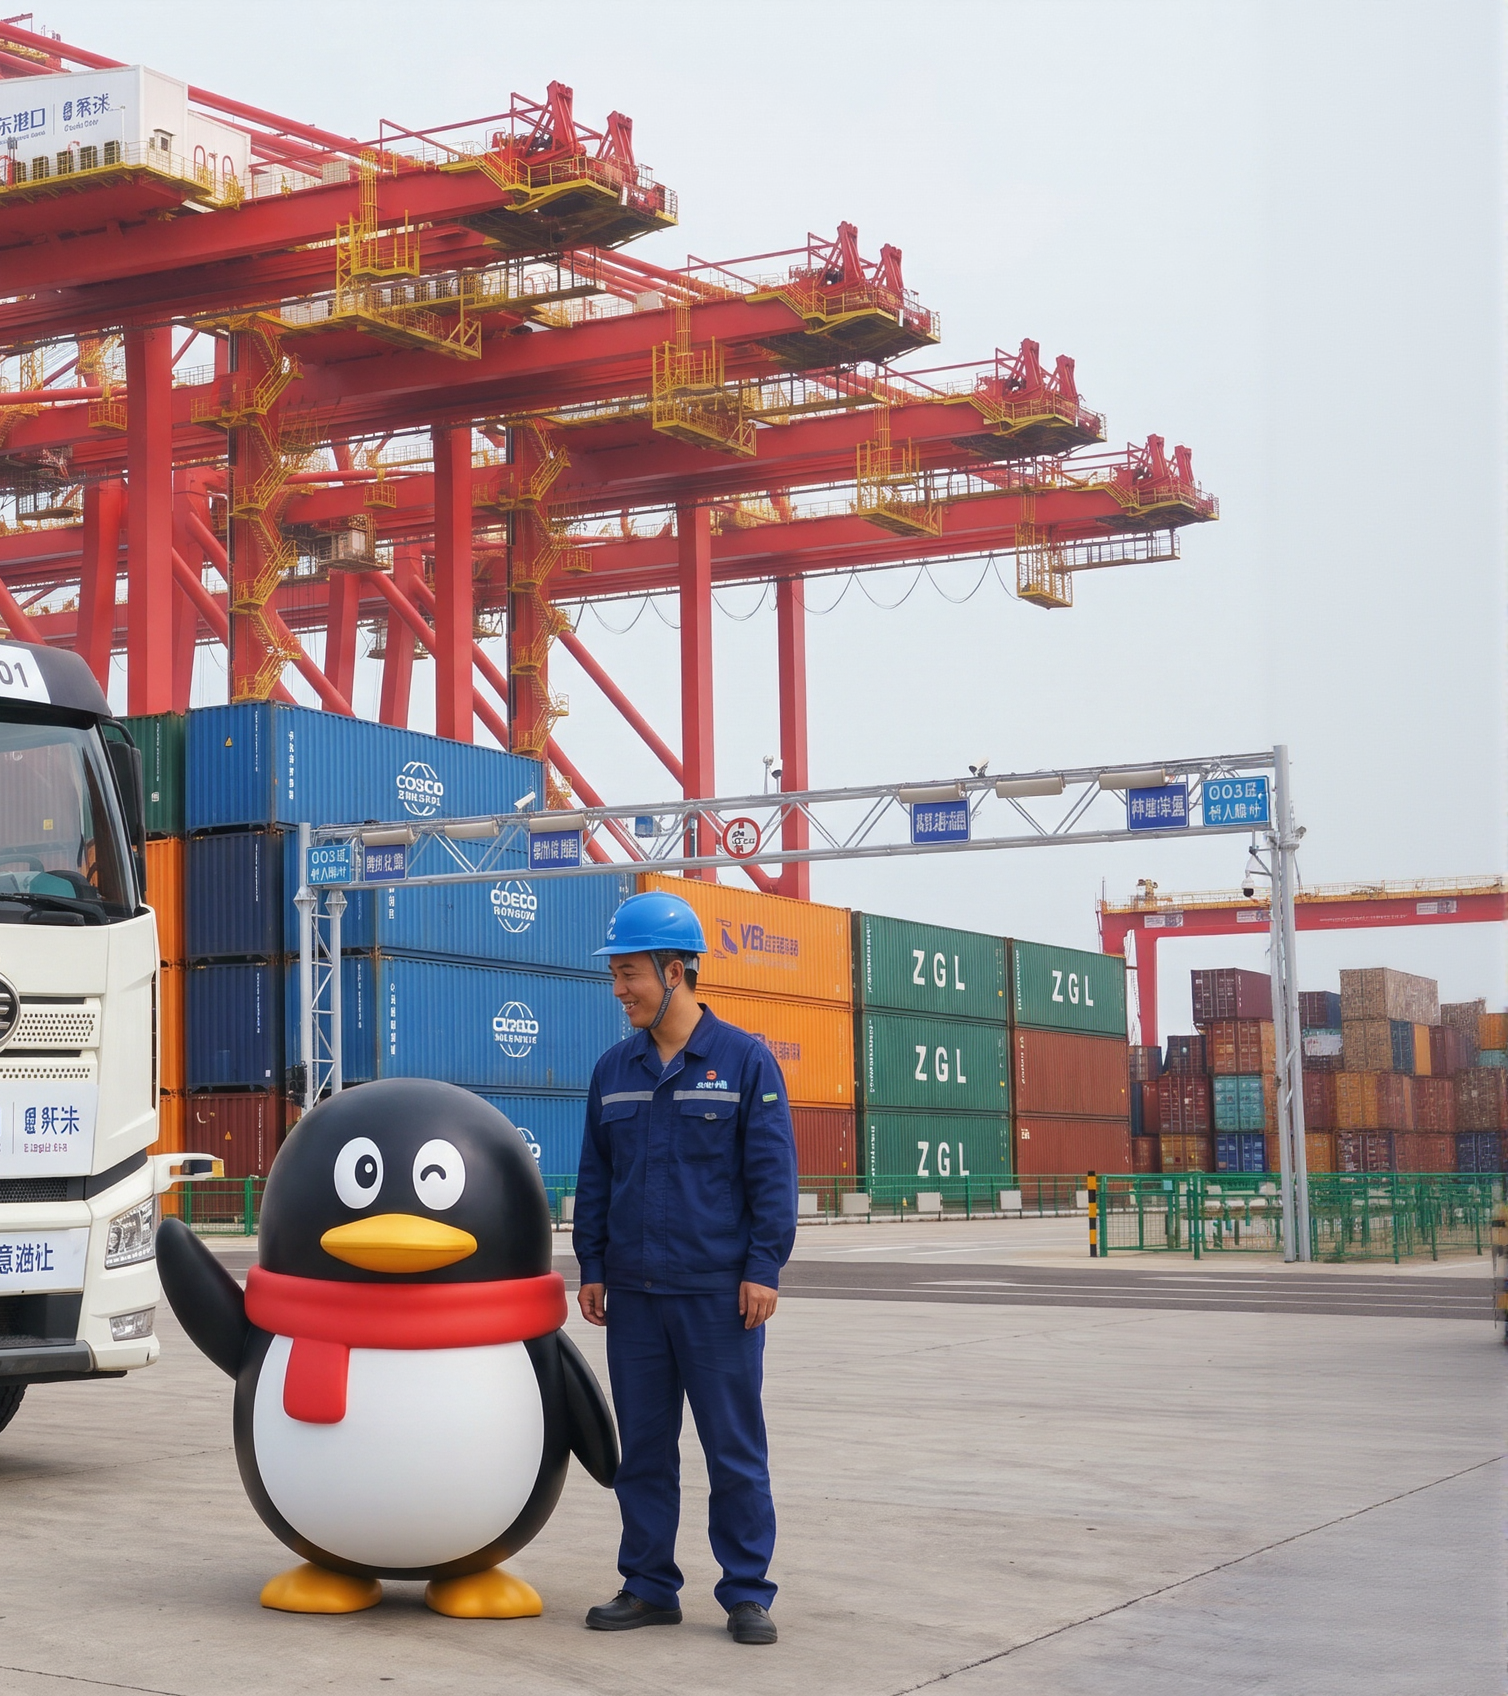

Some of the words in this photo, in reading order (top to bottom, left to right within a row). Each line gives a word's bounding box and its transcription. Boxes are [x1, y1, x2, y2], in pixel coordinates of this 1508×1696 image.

[912, 949, 966, 990] ZGL
[1052, 969, 1094, 1006] ZGL
[914, 1045, 967, 1084] ZGL
[917, 1141, 970, 1178] ZGL
